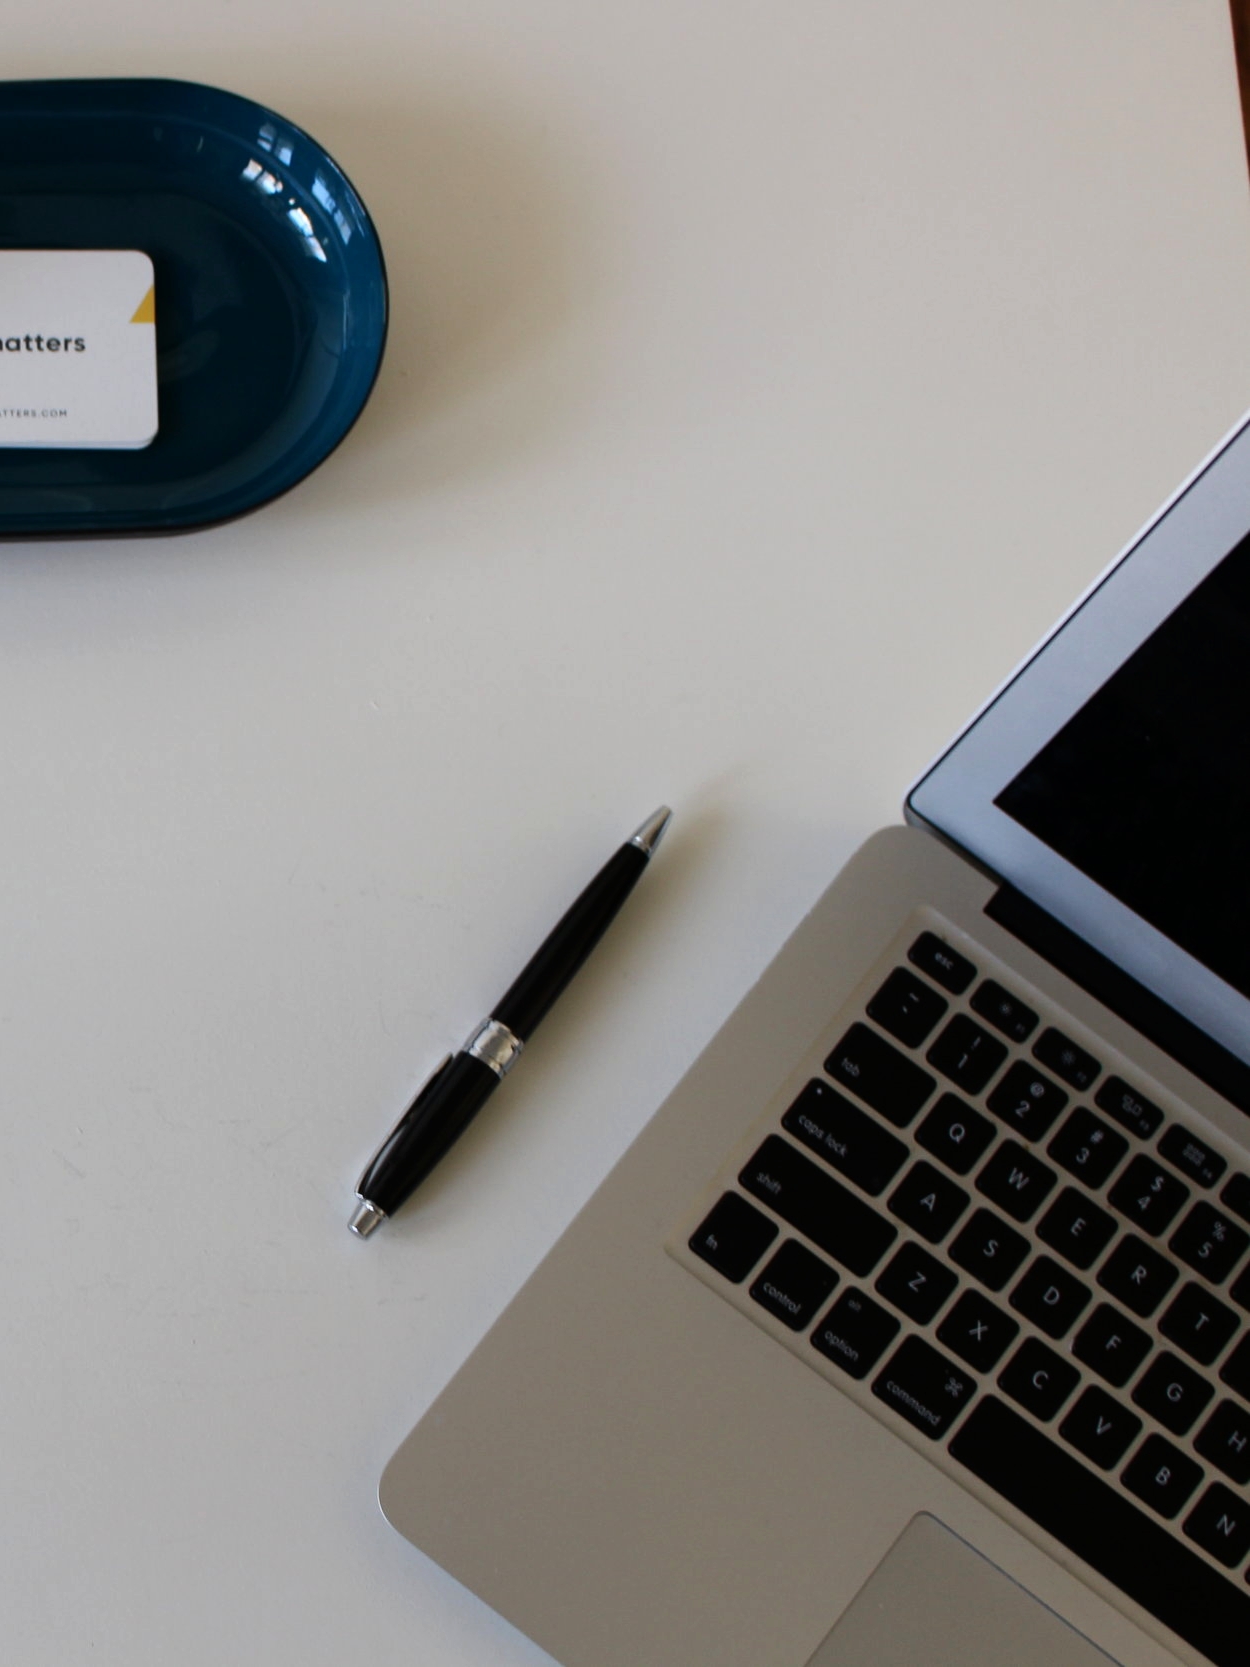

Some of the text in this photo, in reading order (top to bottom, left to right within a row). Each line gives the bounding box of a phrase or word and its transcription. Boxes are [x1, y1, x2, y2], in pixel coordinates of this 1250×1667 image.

[934, 951, 954, 971] esc
[841, 1057, 861, 1078] tab
[957, 1053, 969, 1069] 1
[1029, 1082, 1045, 1098] @
[1014, 1100, 1031, 1118] 2
[798, 1114, 848, 1159] caps lock
[948, 1122, 966, 1144] Q
[1075, 1147, 1090, 1164] 3
[755, 1171, 782, 1197] shift
[1008, 1167, 1030, 1191] W
[1150, 1175, 1164, 1192] $
[920, 1193, 936, 1212] A
[1137, 1195, 1151, 1210] 4
[1070, 1217, 1086, 1236] E
[1211, 1220, 1227, 1243] %
[705, 1233, 718, 1250] fn
[983, 1239, 999, 1257] S
[1197, 1241, 1213, 1258] 5
[907, 1271, 927, 1292] Z
[1131, 1265, 1147, 1285] R
[762, 1281, 802, 1316] control
[1042, 1285, 1061, 1305] D
[968, 1320, 988, 1341] X
[1195, 1312, 1210, 1331] T
[823, 1330, 859, 1362] option
[1105, 1334, 1122, 1350] F
[1032, 1370, 1049, 1390] C
[1166, 1382, 1184, 1402] G
[886, 1379, 942, 1427] command
[1096, 1416, 1112, 1435] V
[1227, 1430, 1247, 1453] H
[1155, 1466, 1171, 1485] B
[1216, 1514, 1236, 1537] N
